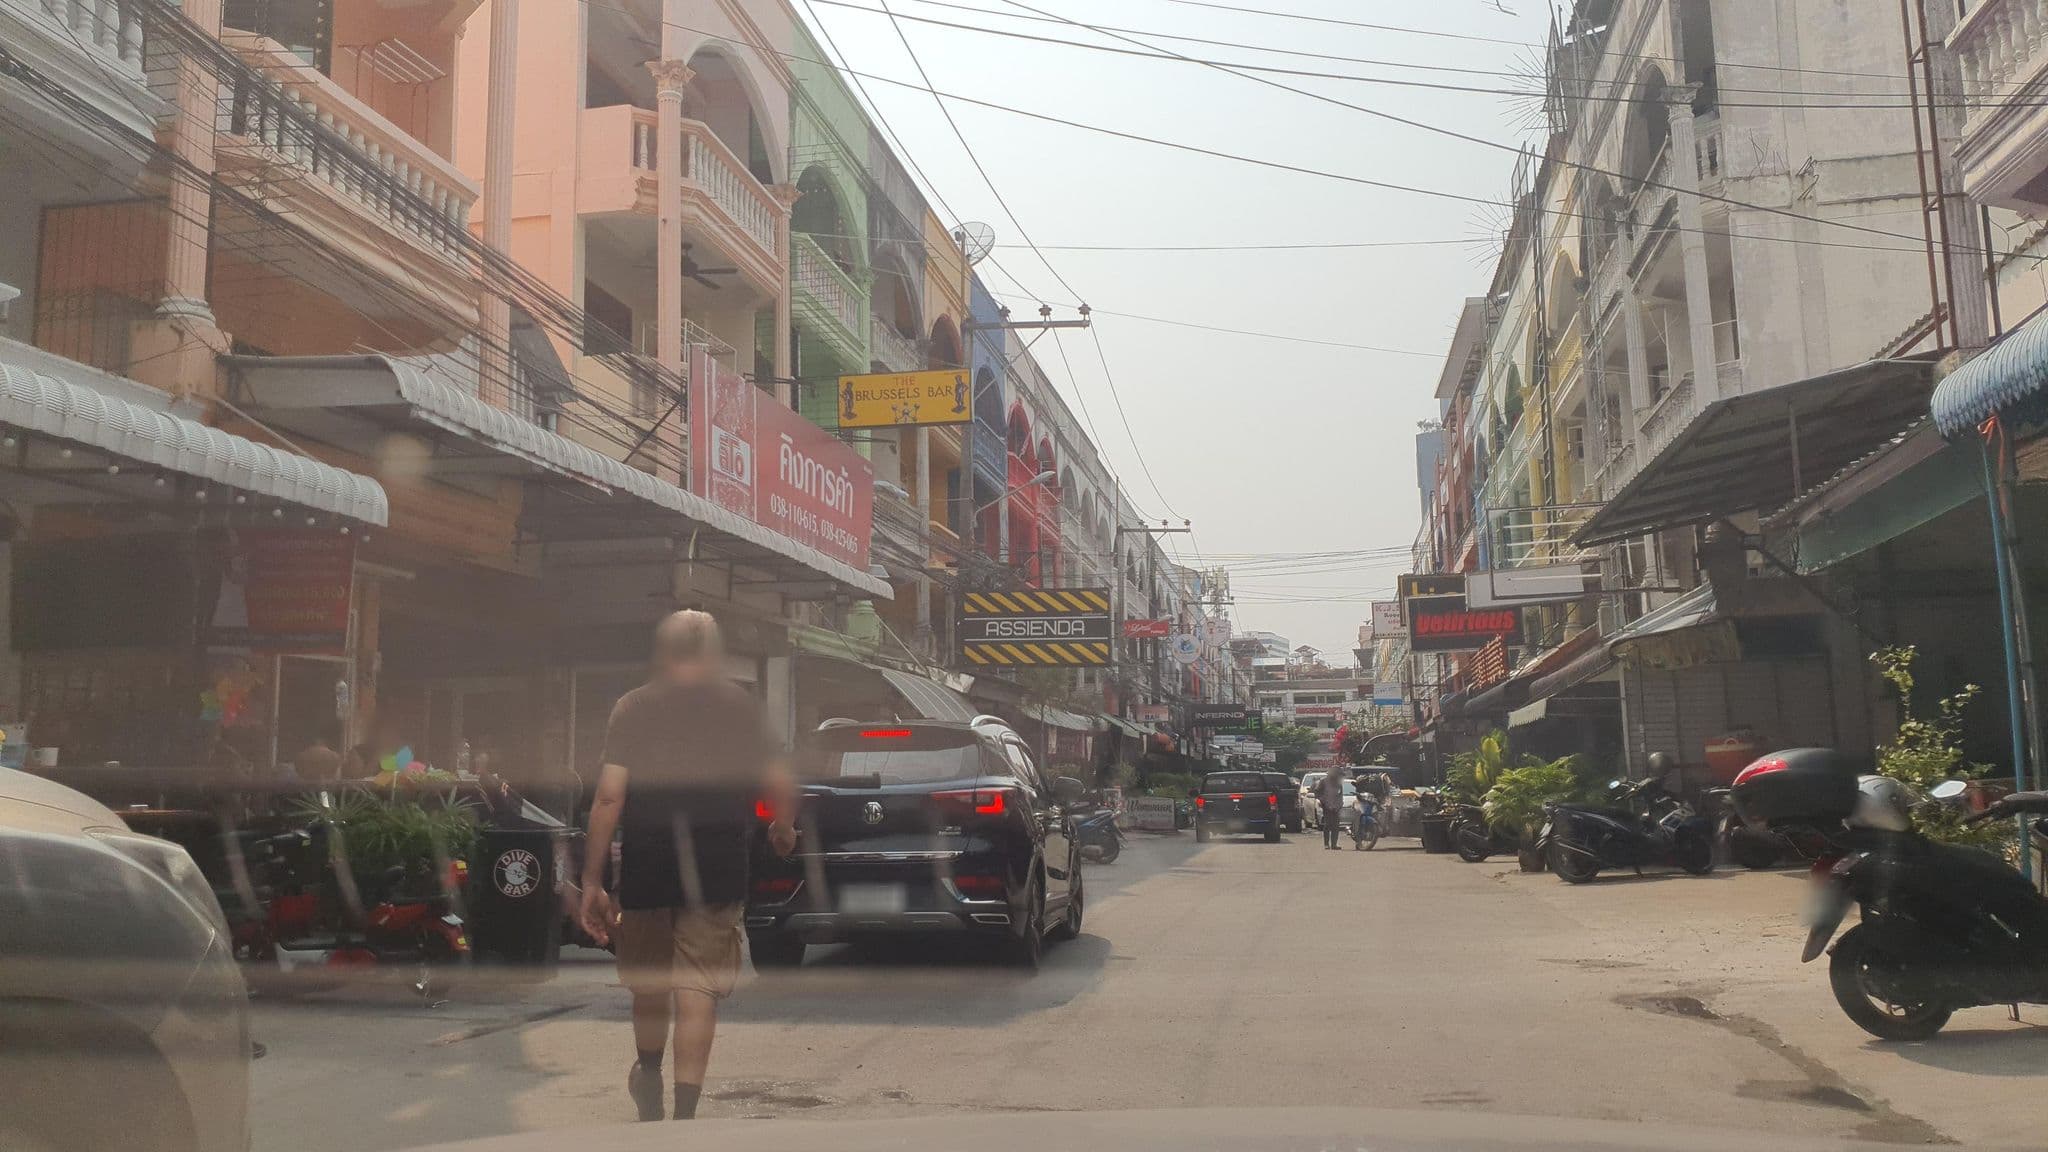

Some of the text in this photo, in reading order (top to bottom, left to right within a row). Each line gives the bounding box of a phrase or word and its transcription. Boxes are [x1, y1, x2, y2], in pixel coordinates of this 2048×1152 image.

[895, 376, 916, 386] THE
[855, 385, 954, 402] BRUSSELS BAR
[985, 620, 1085, 636] ASSIENDA
[501, 852, 533, 866] DIVE
[504, 882, 530, 895] BAR
